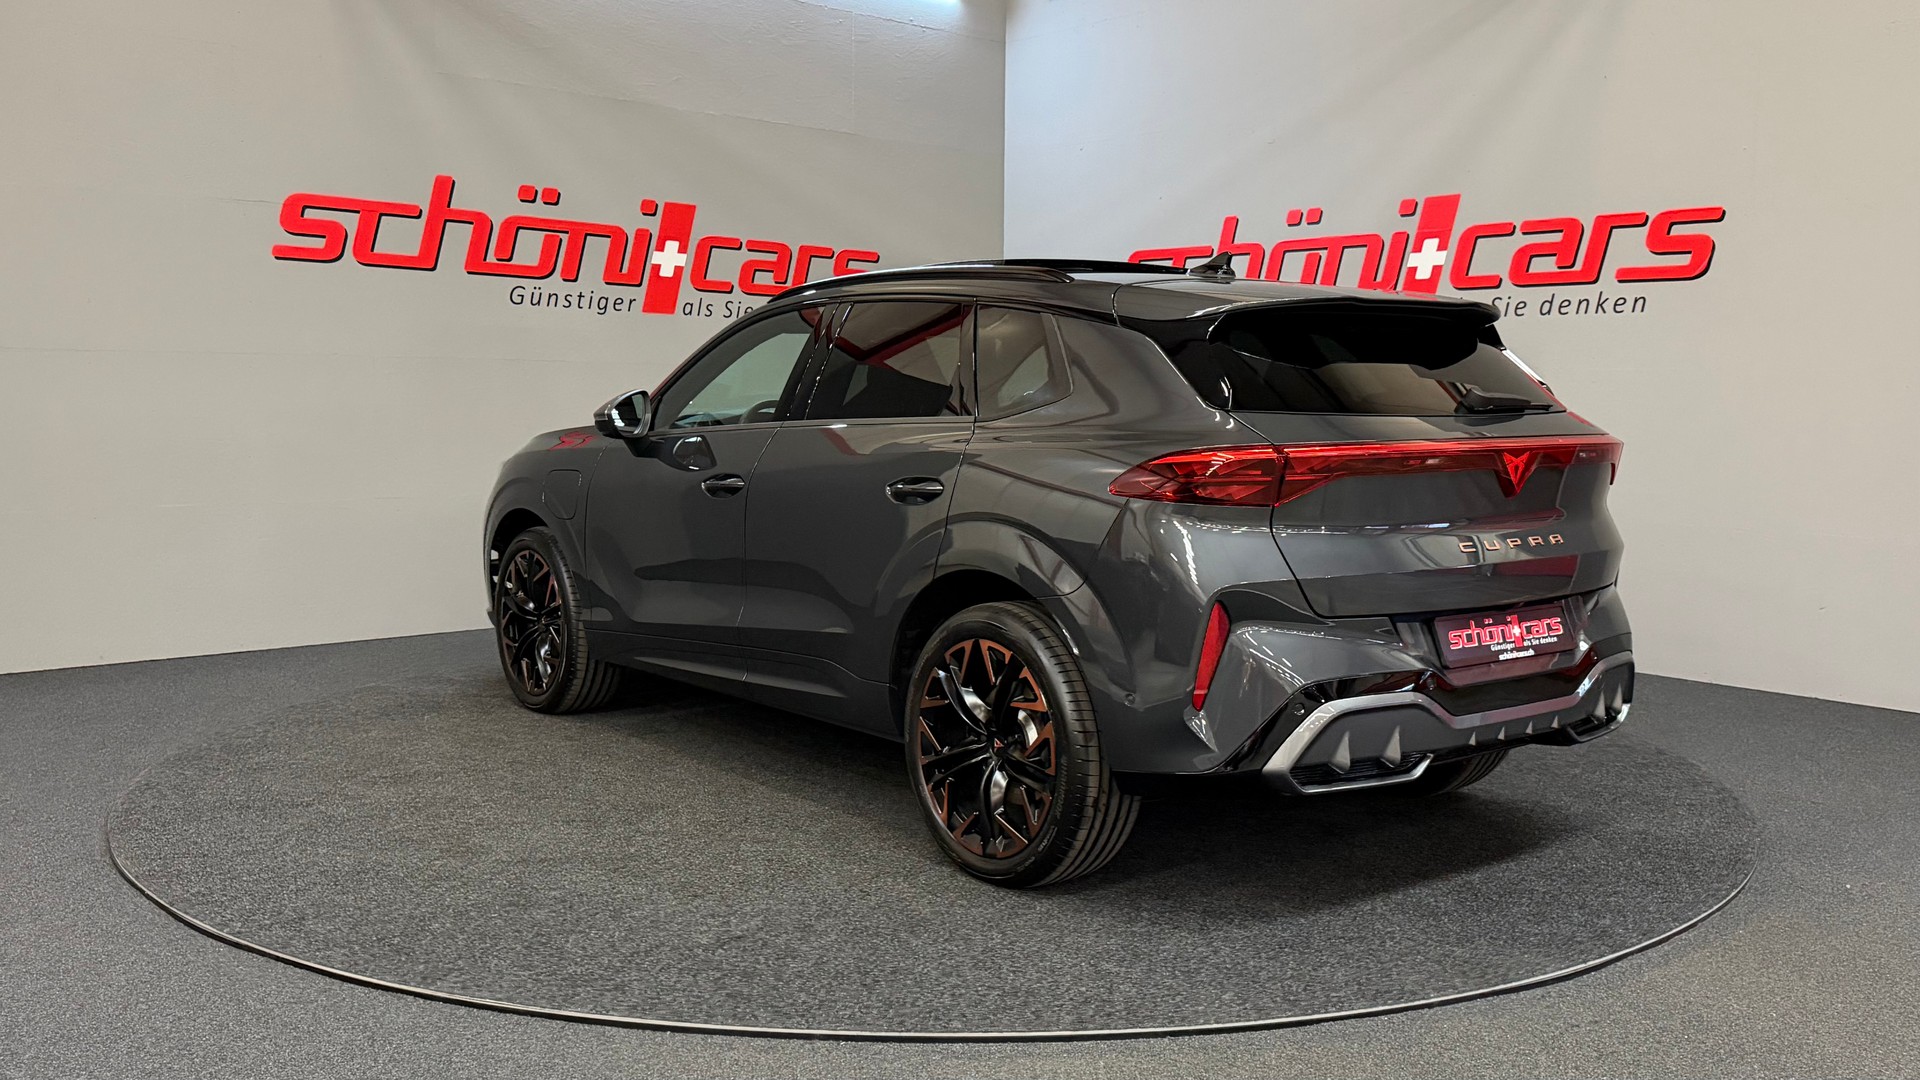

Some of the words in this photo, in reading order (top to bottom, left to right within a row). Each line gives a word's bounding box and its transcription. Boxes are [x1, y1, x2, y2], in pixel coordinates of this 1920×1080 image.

[509, 285, 637, 315] Günstiger
[683, 297, 714, 317] als
[1539, 291, 1647, 316] denken
[1459, 533, 1564, 553] CUPRA
